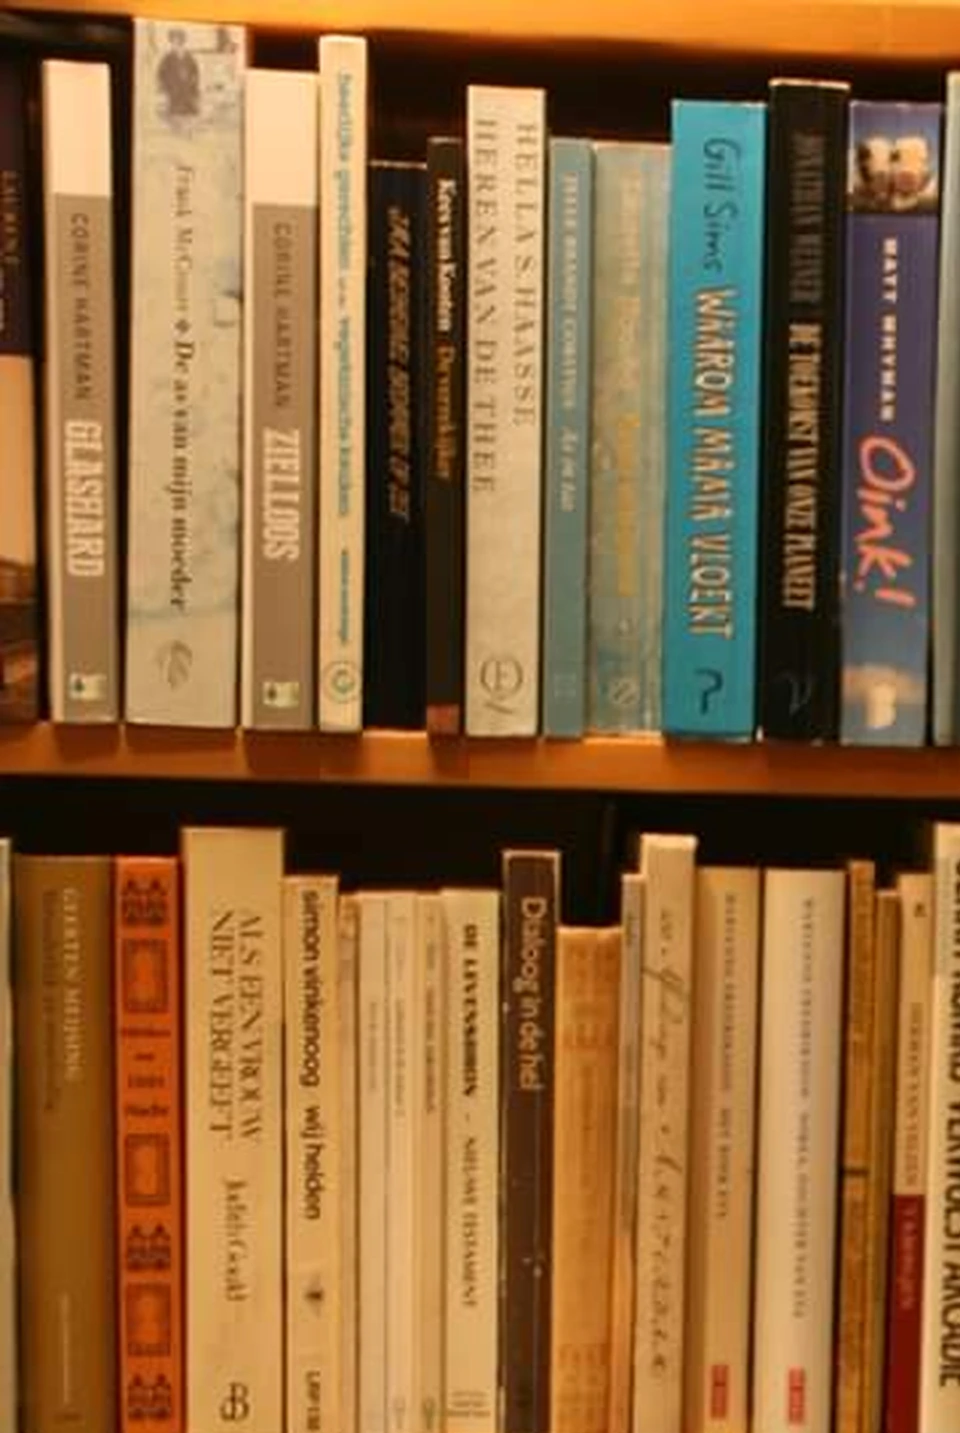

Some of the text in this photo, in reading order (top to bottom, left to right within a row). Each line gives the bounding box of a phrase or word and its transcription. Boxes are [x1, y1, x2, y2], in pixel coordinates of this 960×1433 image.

[515, 123, 537, 246] HELLA
[702, 138, 734, 191] Gill
[702, 206, 734, 270] Sims
[436, 258, 456, 331] Kooten
[471, 119, 497, 494] HEREN VAN DE THEE
[789, 322, 818, 345] DE
[74, 298, 91, 399] HARTMAN
[174, 341, 193, 369] De
[273, 307, 290, 407] HARTMAN
[512, 293, 535, 427] HAASSE
[172, 409, 190, 449] van
[787, 348, 818, 448] TOEKOMST
[855, 239, 915, 607] MATT WHYMAN Oink!
[64, 420, 104, 576] GLASHARD
[169, 456, 193, 512] mijn
[263, 428, 299, 559] ZIELLOOS
[785, 481, 815, 531] ONZE
[786, 450, 816, 478] VAN
[170, 517, 193, 612] moeder
[689, 534, 731, 638] VLOEKT
[782, 534, 814, 612] PLANEET
[515, 898, 546, 993] Dialoog
[211, 910, 233, 1139] NIET VERGEEFT
[241, 913, 262, 1144] ALS EEN VROUW
[299, 890, 324, 1219] simon vinkenoog wij helden
[520, 1054, 543, 1090] hel
